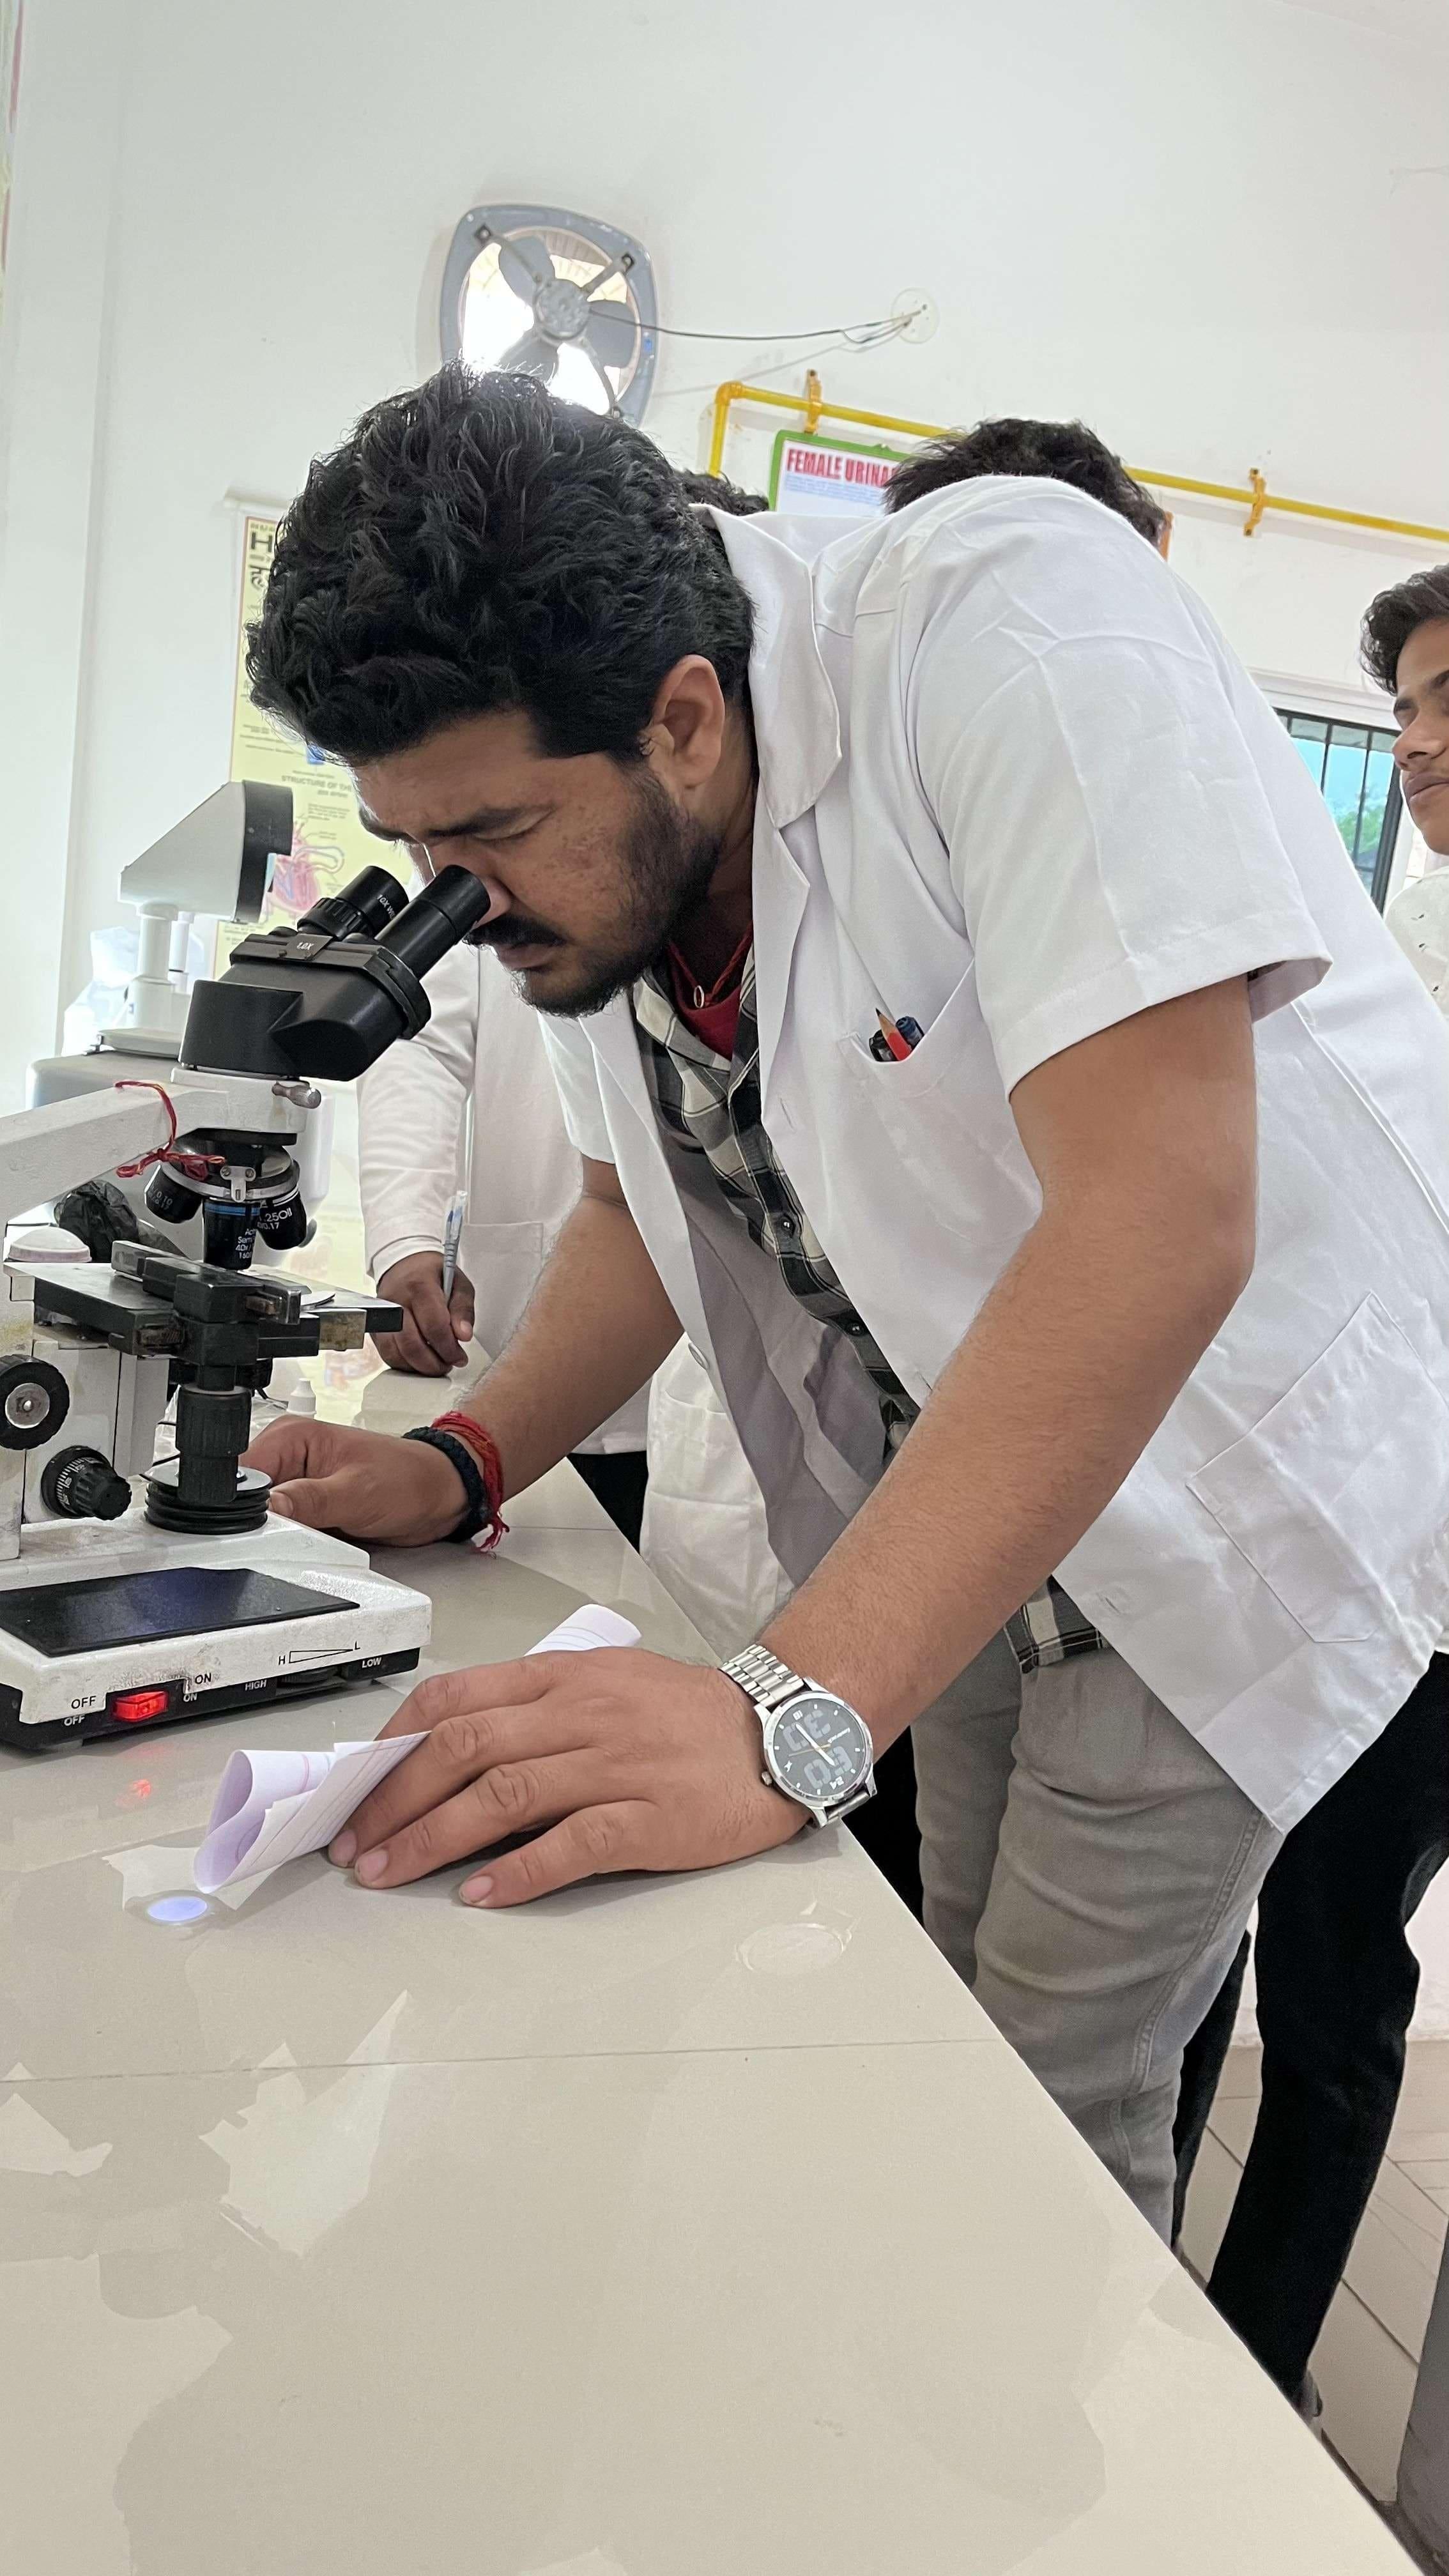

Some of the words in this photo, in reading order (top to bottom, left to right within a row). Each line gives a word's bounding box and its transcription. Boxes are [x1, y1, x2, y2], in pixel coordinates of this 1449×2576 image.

[787, 448, 843, 479] FEMALE
[377, 894, 390, 908] 10X
[354, 1641, 360, 1651] L
[278, 1655, 286, 1666] H
[362, 1657, 382, 1669] LOW
[194, 1673, 212, 1684] ON
[245, 1679, 267, 1691] HIGH
[71, 1696, 96, 1710] OFF
[183, 1693, 198, 1703] ON
[64, 1713, 86, 1727] OFF
